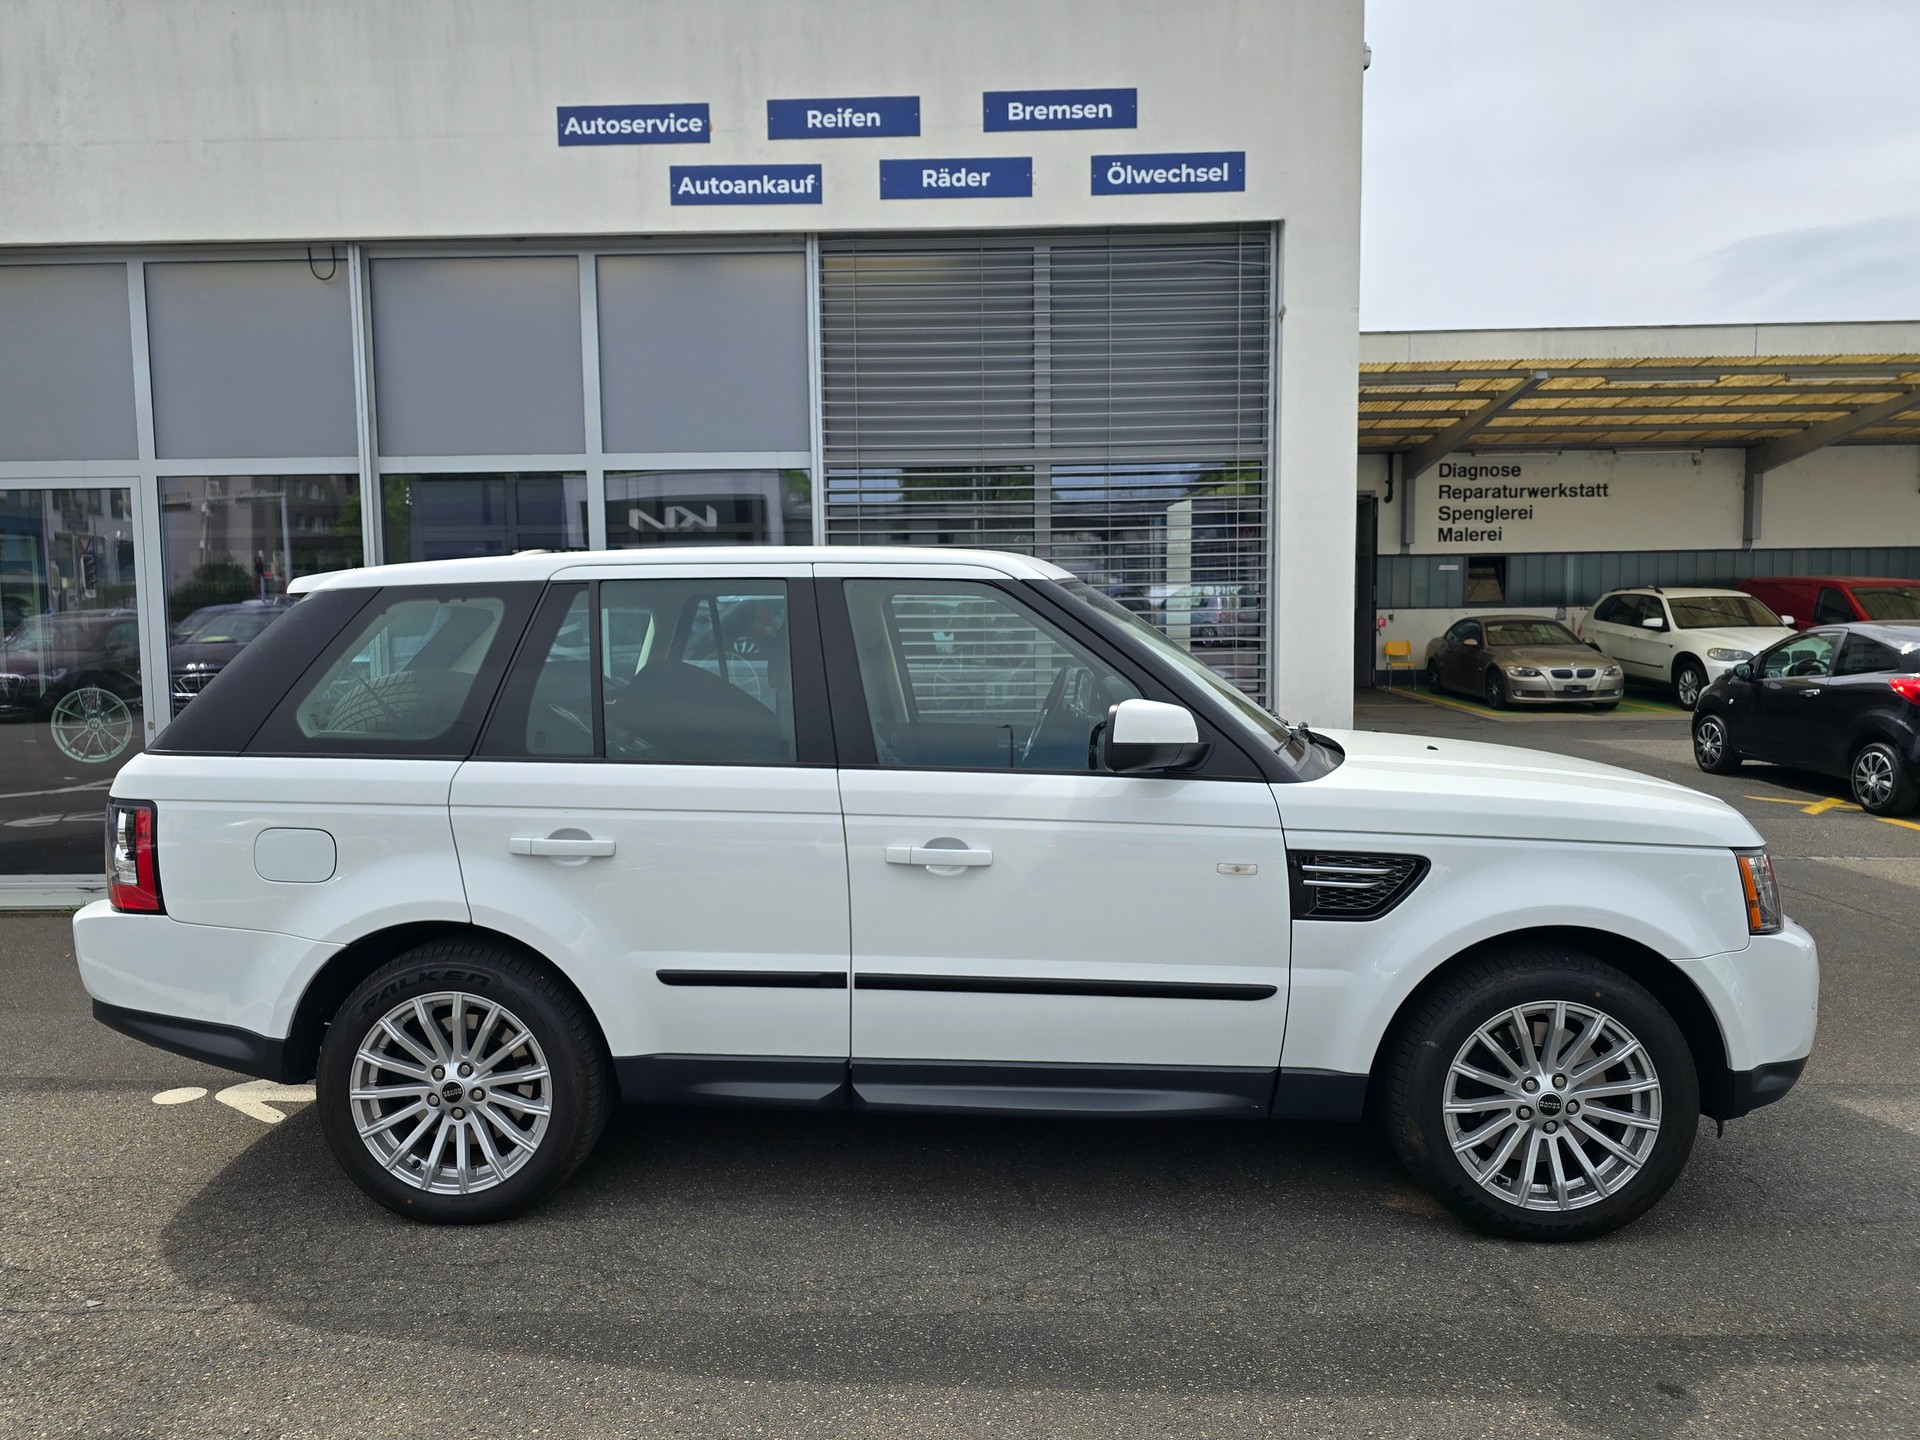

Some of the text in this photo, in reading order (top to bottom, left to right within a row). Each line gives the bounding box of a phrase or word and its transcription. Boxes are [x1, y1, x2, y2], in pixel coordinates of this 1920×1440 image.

[806, 108, 882, 129] Reifen
[1007, 101, 1113, 122] Bremsen
[564, 113, 704, 136] Autoservice
[921, 167, 991, 189] Räder
[1106, 163, 1230, 186] Ölwechsel
[677, 175, 816, 196] Autoankauf
[1438, 462, 1521, 480] Diagnose
[1438, 482, 1609, 503] Reparaturwerkstatt
[1438, 504, 1534, 524] Spenglerei
[1437, 527, 1503, 543] Malerei
